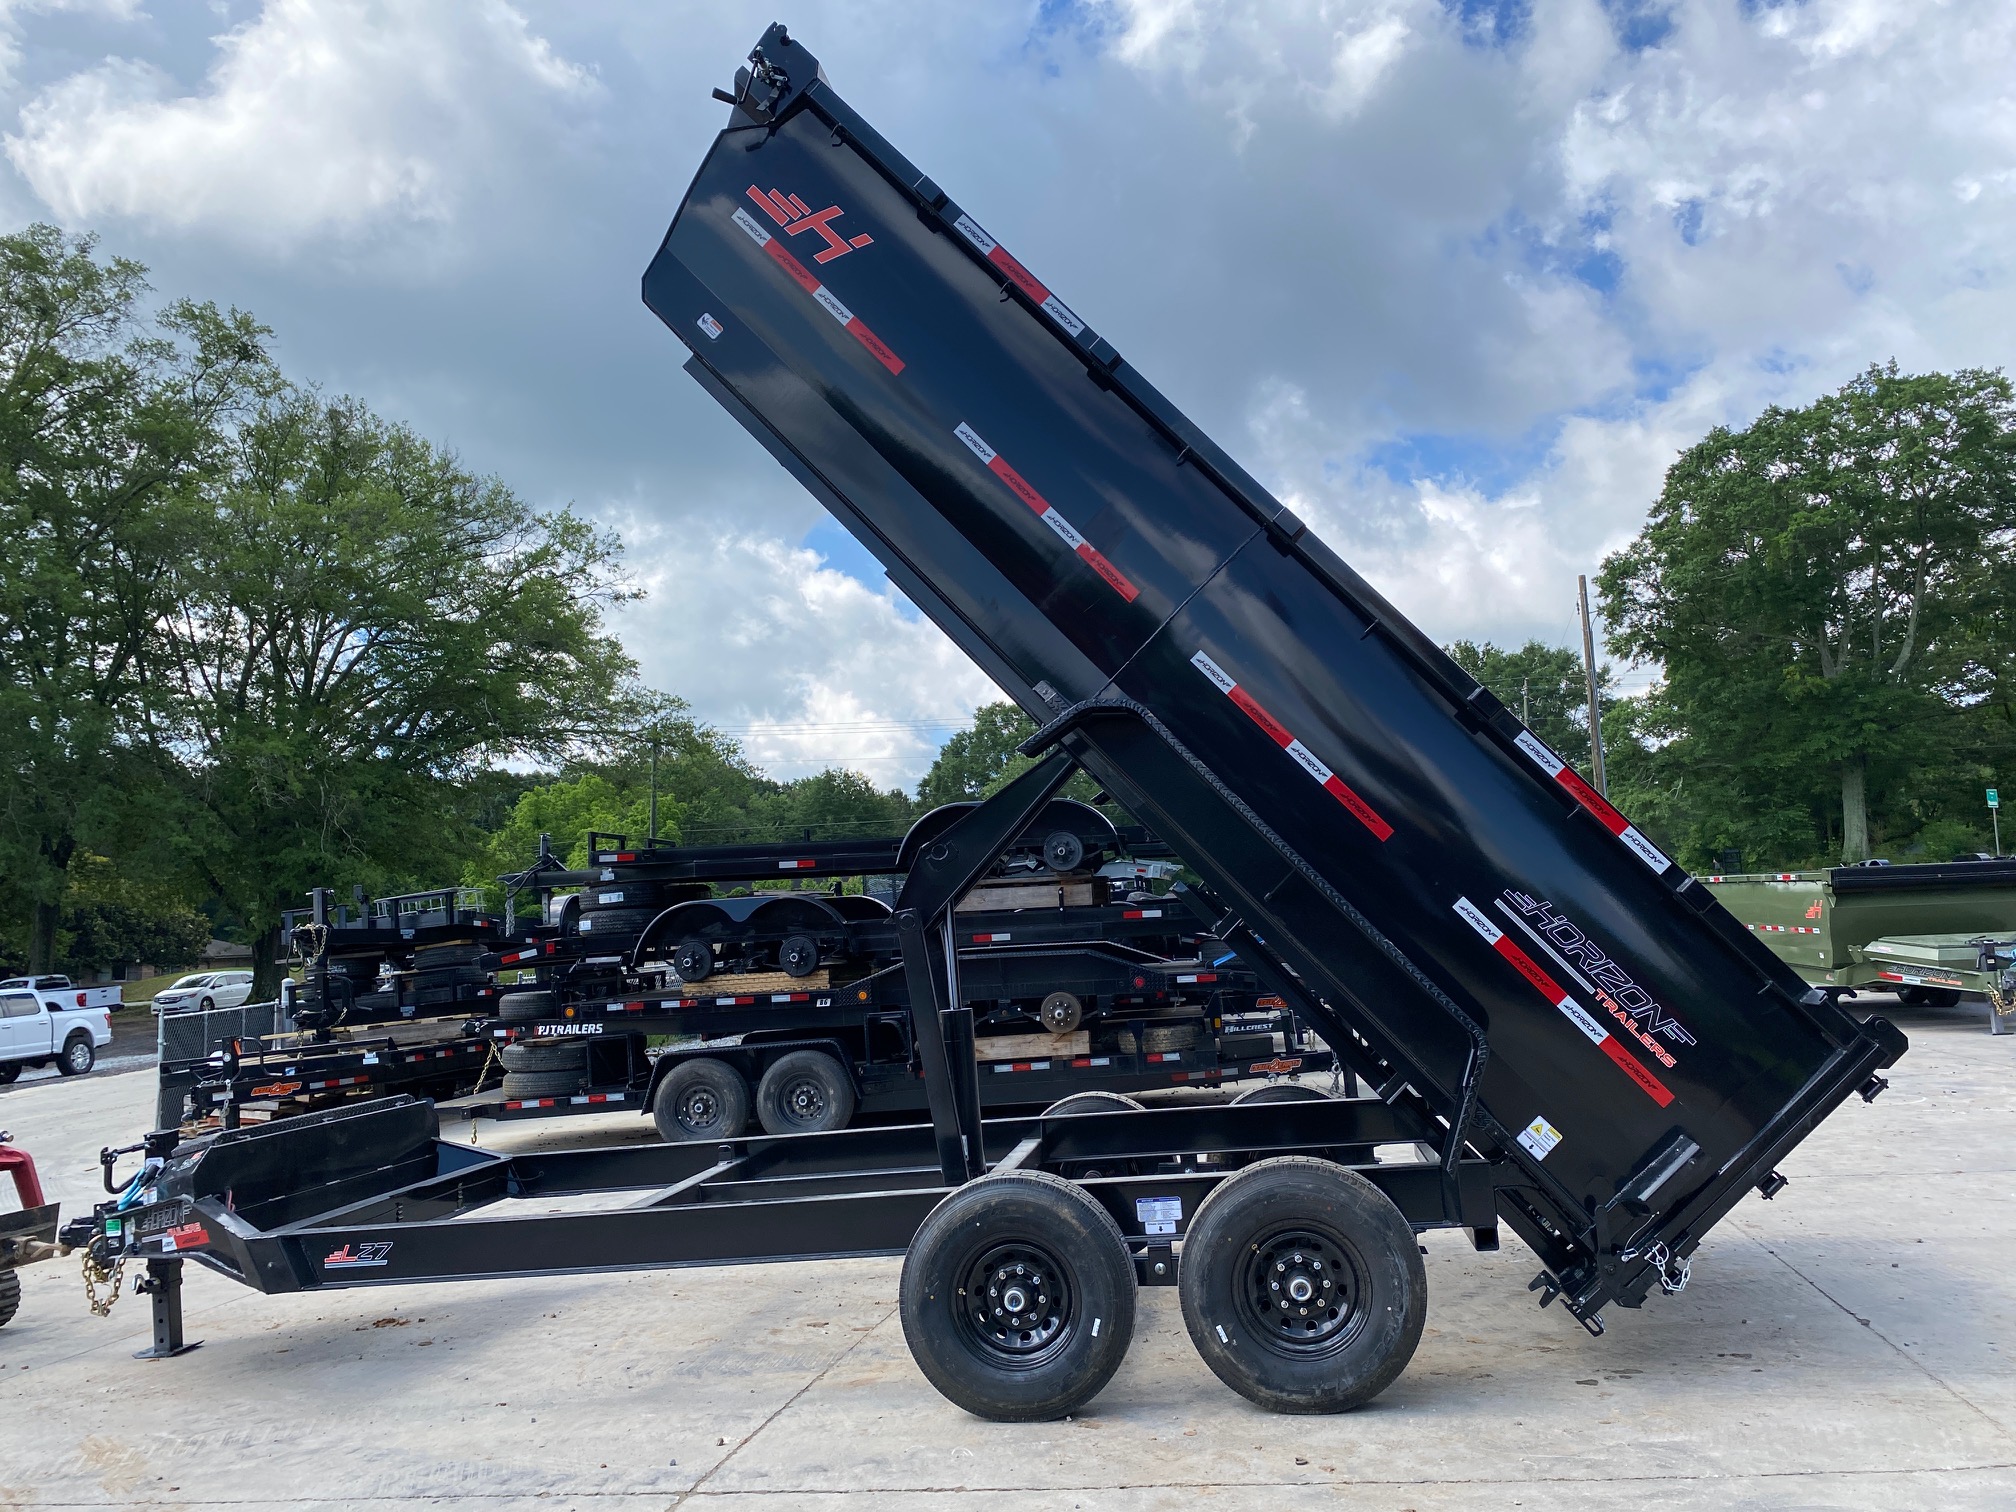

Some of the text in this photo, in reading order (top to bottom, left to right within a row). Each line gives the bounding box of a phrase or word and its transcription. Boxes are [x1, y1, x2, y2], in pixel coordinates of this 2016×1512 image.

[737, 216, 767, 241] HORIZON
[958, 221, 991, 248] HORIZON
[818, 293, 850, 320] HORIZON
[1045, 302, 1079, 329] HORIZON
[958, 429, 993, 458] HORIZON
[1046, 515, 1080, 543] HORIZON
[1195, 658, 1232, 688] HORIZON
[1290, 746, 1329, 778] HORIZON
[1518, 738, 1558, 770] HORIZON
[1623, 832, 1664, 866] HORIZON
[1458, 905, 1499, 938] HORIZON
[1503, 889, 1697, 1046] HORIZON
[1886, 965, 1962, 980] HORIZON
[1224, 1023, 1274, 1034] HILLCREST
[1563, 1004, 1604, 1038] HORIZON
[1594, 988, 1677, 1068] TRAILERS
[1617, 1056, 1658, 1091] HORIZON
